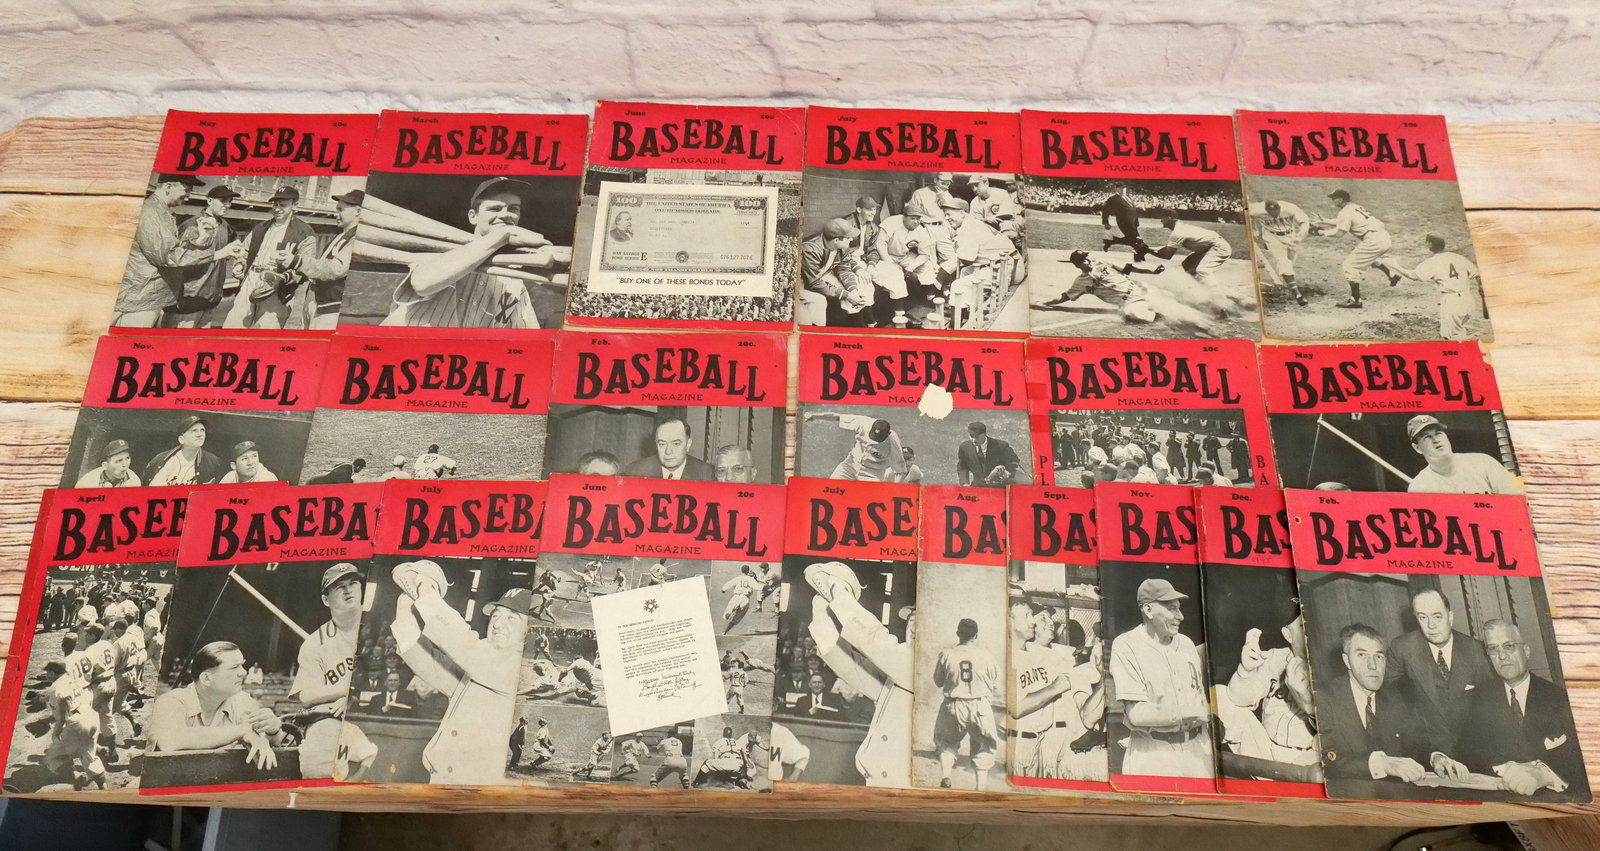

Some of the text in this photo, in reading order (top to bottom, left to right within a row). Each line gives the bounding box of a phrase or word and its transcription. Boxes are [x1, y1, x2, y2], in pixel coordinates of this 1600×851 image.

[609, 119, 784, 165] BASEBALL
[825, 123, 1001, 169] BASEBALL
[176, 128, 351, 172] BASEBALL
[392, 125, 567, 171] BASEBALL
[1040, 126, 1218, 172] BASEBALL
[1258, 126, 1438, 173] BASEBALL
[887, 160, 944, 168] MAGAZINE
[640, 252, 648, 261] E
[1449, 263, 1459, 280] 4
[106, 352, 299, 406] BASEBALL
[573, 348, 766, 401] BASEBALL
[820, 350, 1013, 406] BASEBALL
[1046, 351, 1241, 405] BASEBALL
[339, 354, 530, 409] BASEBALL
[1285, 355, 1485, 409] BASEBALL
[174, 397, 236, 405] MAGAZINE
[406, 400, 468, 408] MAGAZINE
[888, 396, 921, 404] MAGA
[1360, 401, 1423, 409] MAGAZINE
[423, 456, 438, 464] 27
[420, 485, 442, 494] July
[582, 483, 607, 491] June
[823, 486, 845, 495] July
[77, 495, 106, 503] April
[956, 493, 980, 503] Aug.
[1044, 492, 1070, 500] Sept.
[1130, 490, 1153, 498] Nov.
[1231, 493, 1252, 501] Dec.
[229, 498, 249, 506] May
[562, 493, 768, 556] BASEBALL
[1309, 508, 1518, 570] BASEBALL
[280, 548, 347, 559] MAGAZINE
[470, 545, 535, 553] MAGAZINE
[634, 544, 701, 554] MAGAZINE
[1387, 559, 1454, 569] MAGAZINE
[103, 648, 112, 664] 6
[75, 656, 93, 674] 18
[959, 660, 973, 682] 8
